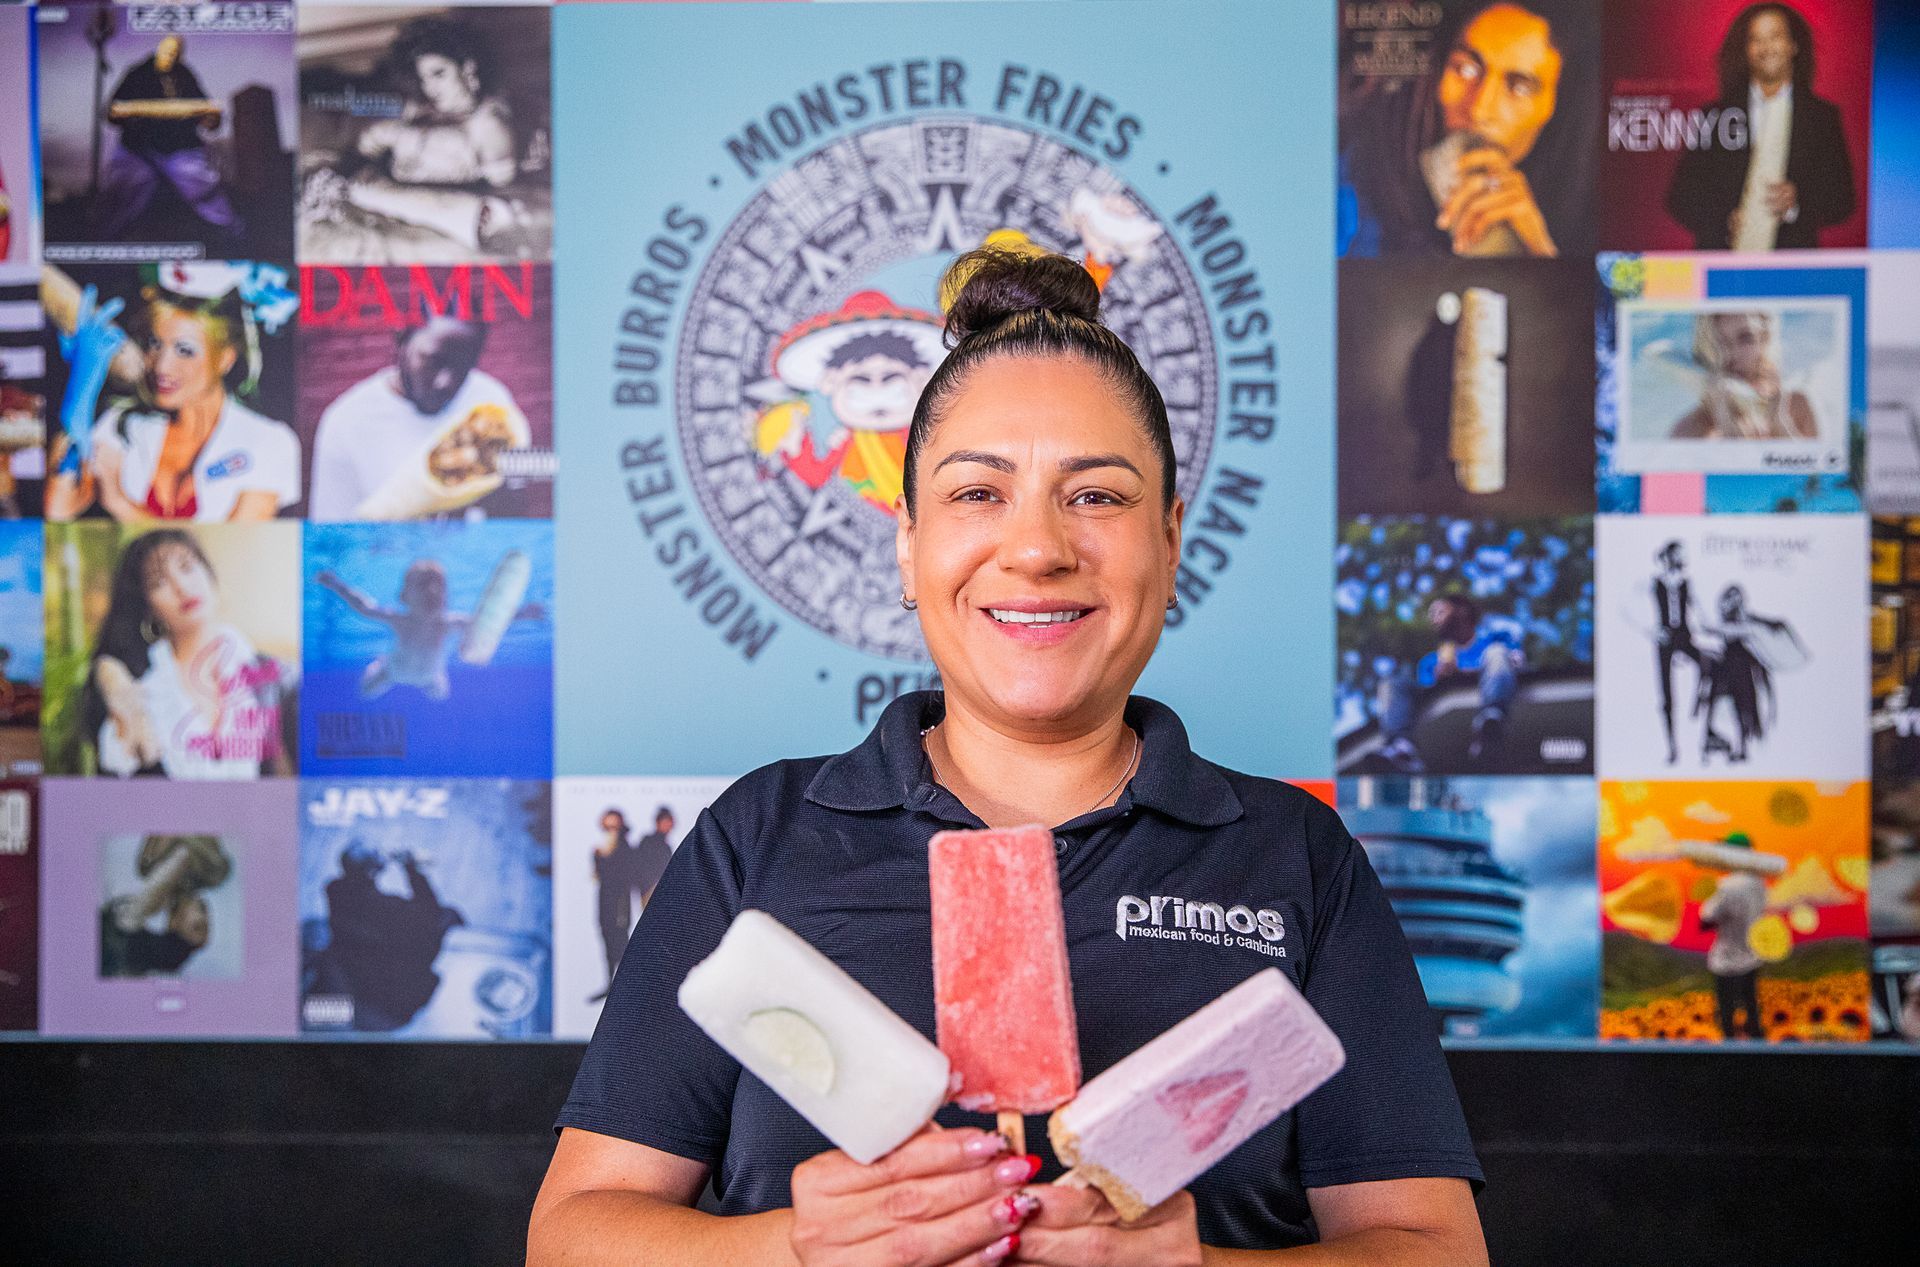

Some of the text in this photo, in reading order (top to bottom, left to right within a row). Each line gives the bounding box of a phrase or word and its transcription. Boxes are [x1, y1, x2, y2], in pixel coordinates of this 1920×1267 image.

[726, 58, 1142, 178] MONSTER FRIES
[1608, 107, 1749, 151] KENNY G
[298, 262, 535, 328] DAMN
[613, 206, 709, 406] BURROS
[1174, 193, 1279, 443] MONSTER
[620, 434, 780, 662] MONSTER
[307, 787, 450, 818] JAY-Z
[1115, 894, 1286, 942] primos
[1128, 924, 1187, 941] mexican
[1190, 928, 1220, 945] food
[1223, 933, 1234, 947] &
